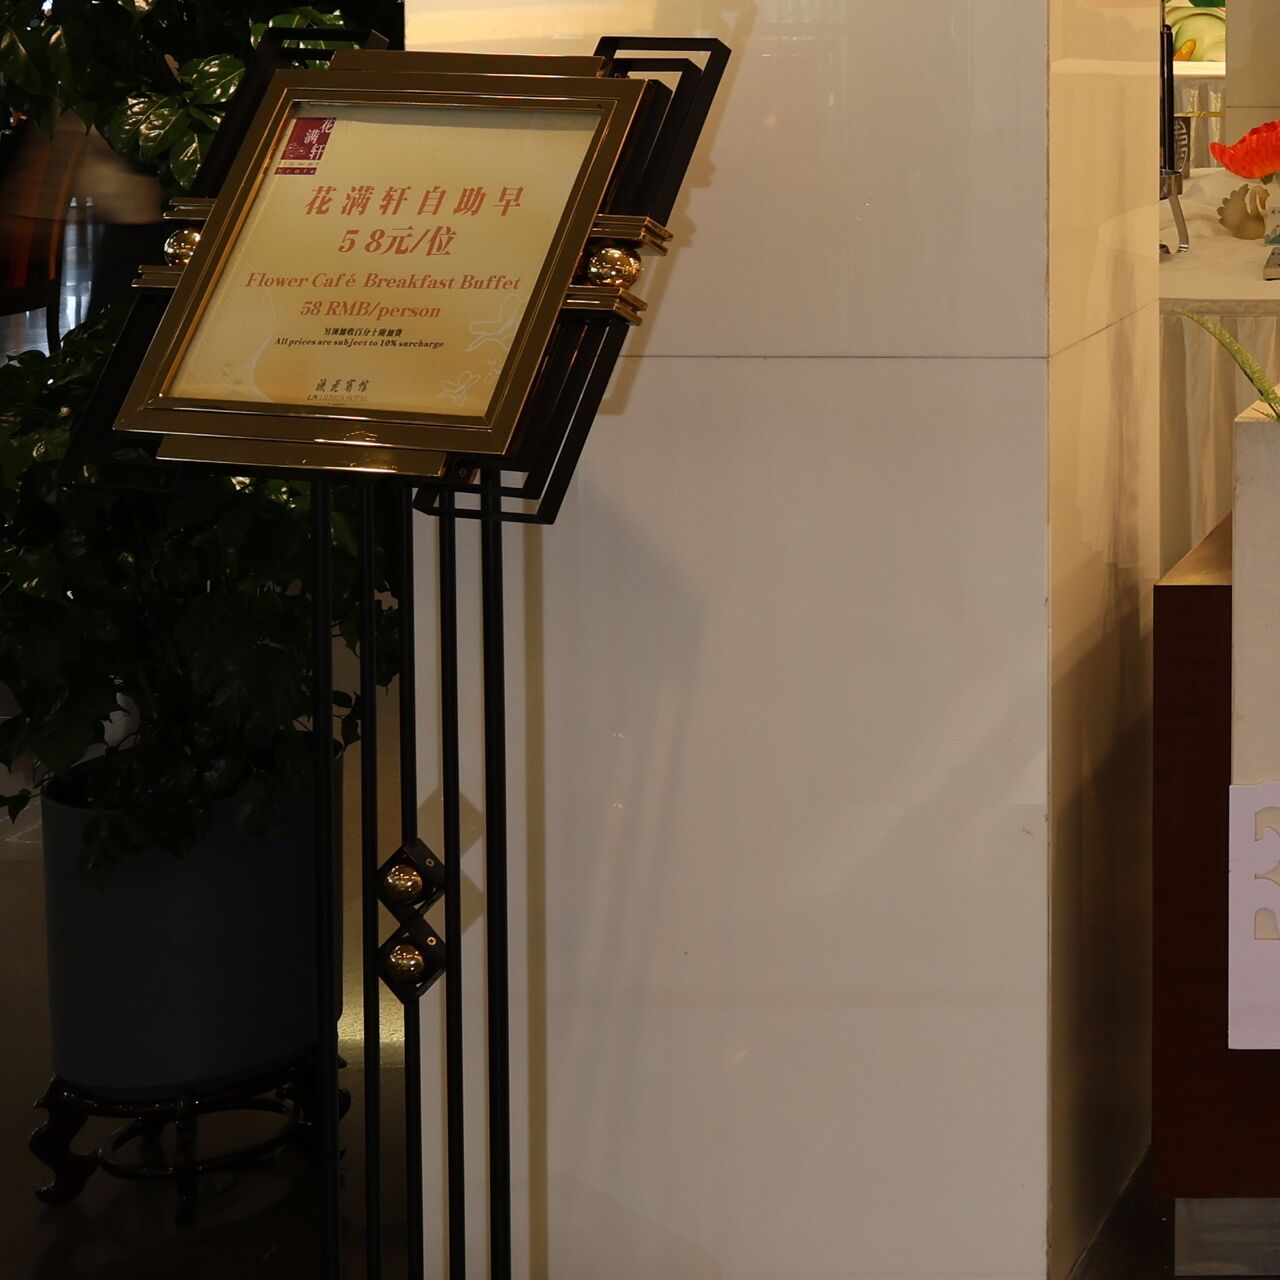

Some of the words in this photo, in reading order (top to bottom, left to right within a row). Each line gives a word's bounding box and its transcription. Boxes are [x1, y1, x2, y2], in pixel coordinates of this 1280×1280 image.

[303, 117, 337, 160] 花满轩
[304, 185, 525, 217] 花满轩自助早
[244, 272, 309, 288] Flower
[311, 272, 357, 289] Café
[362, 273, 455, 290] Breakfast
[458, 274, 521, 291] Buffet
[300, 300, 322, 316] 58
[325, 301, 441, 321] RMB/person
[288, 338, 316, 347] prices
[333, 338, 369, 348] subject
[380, 339, 397, 347] 10%
[398, 340, 445, 349] surcharge
